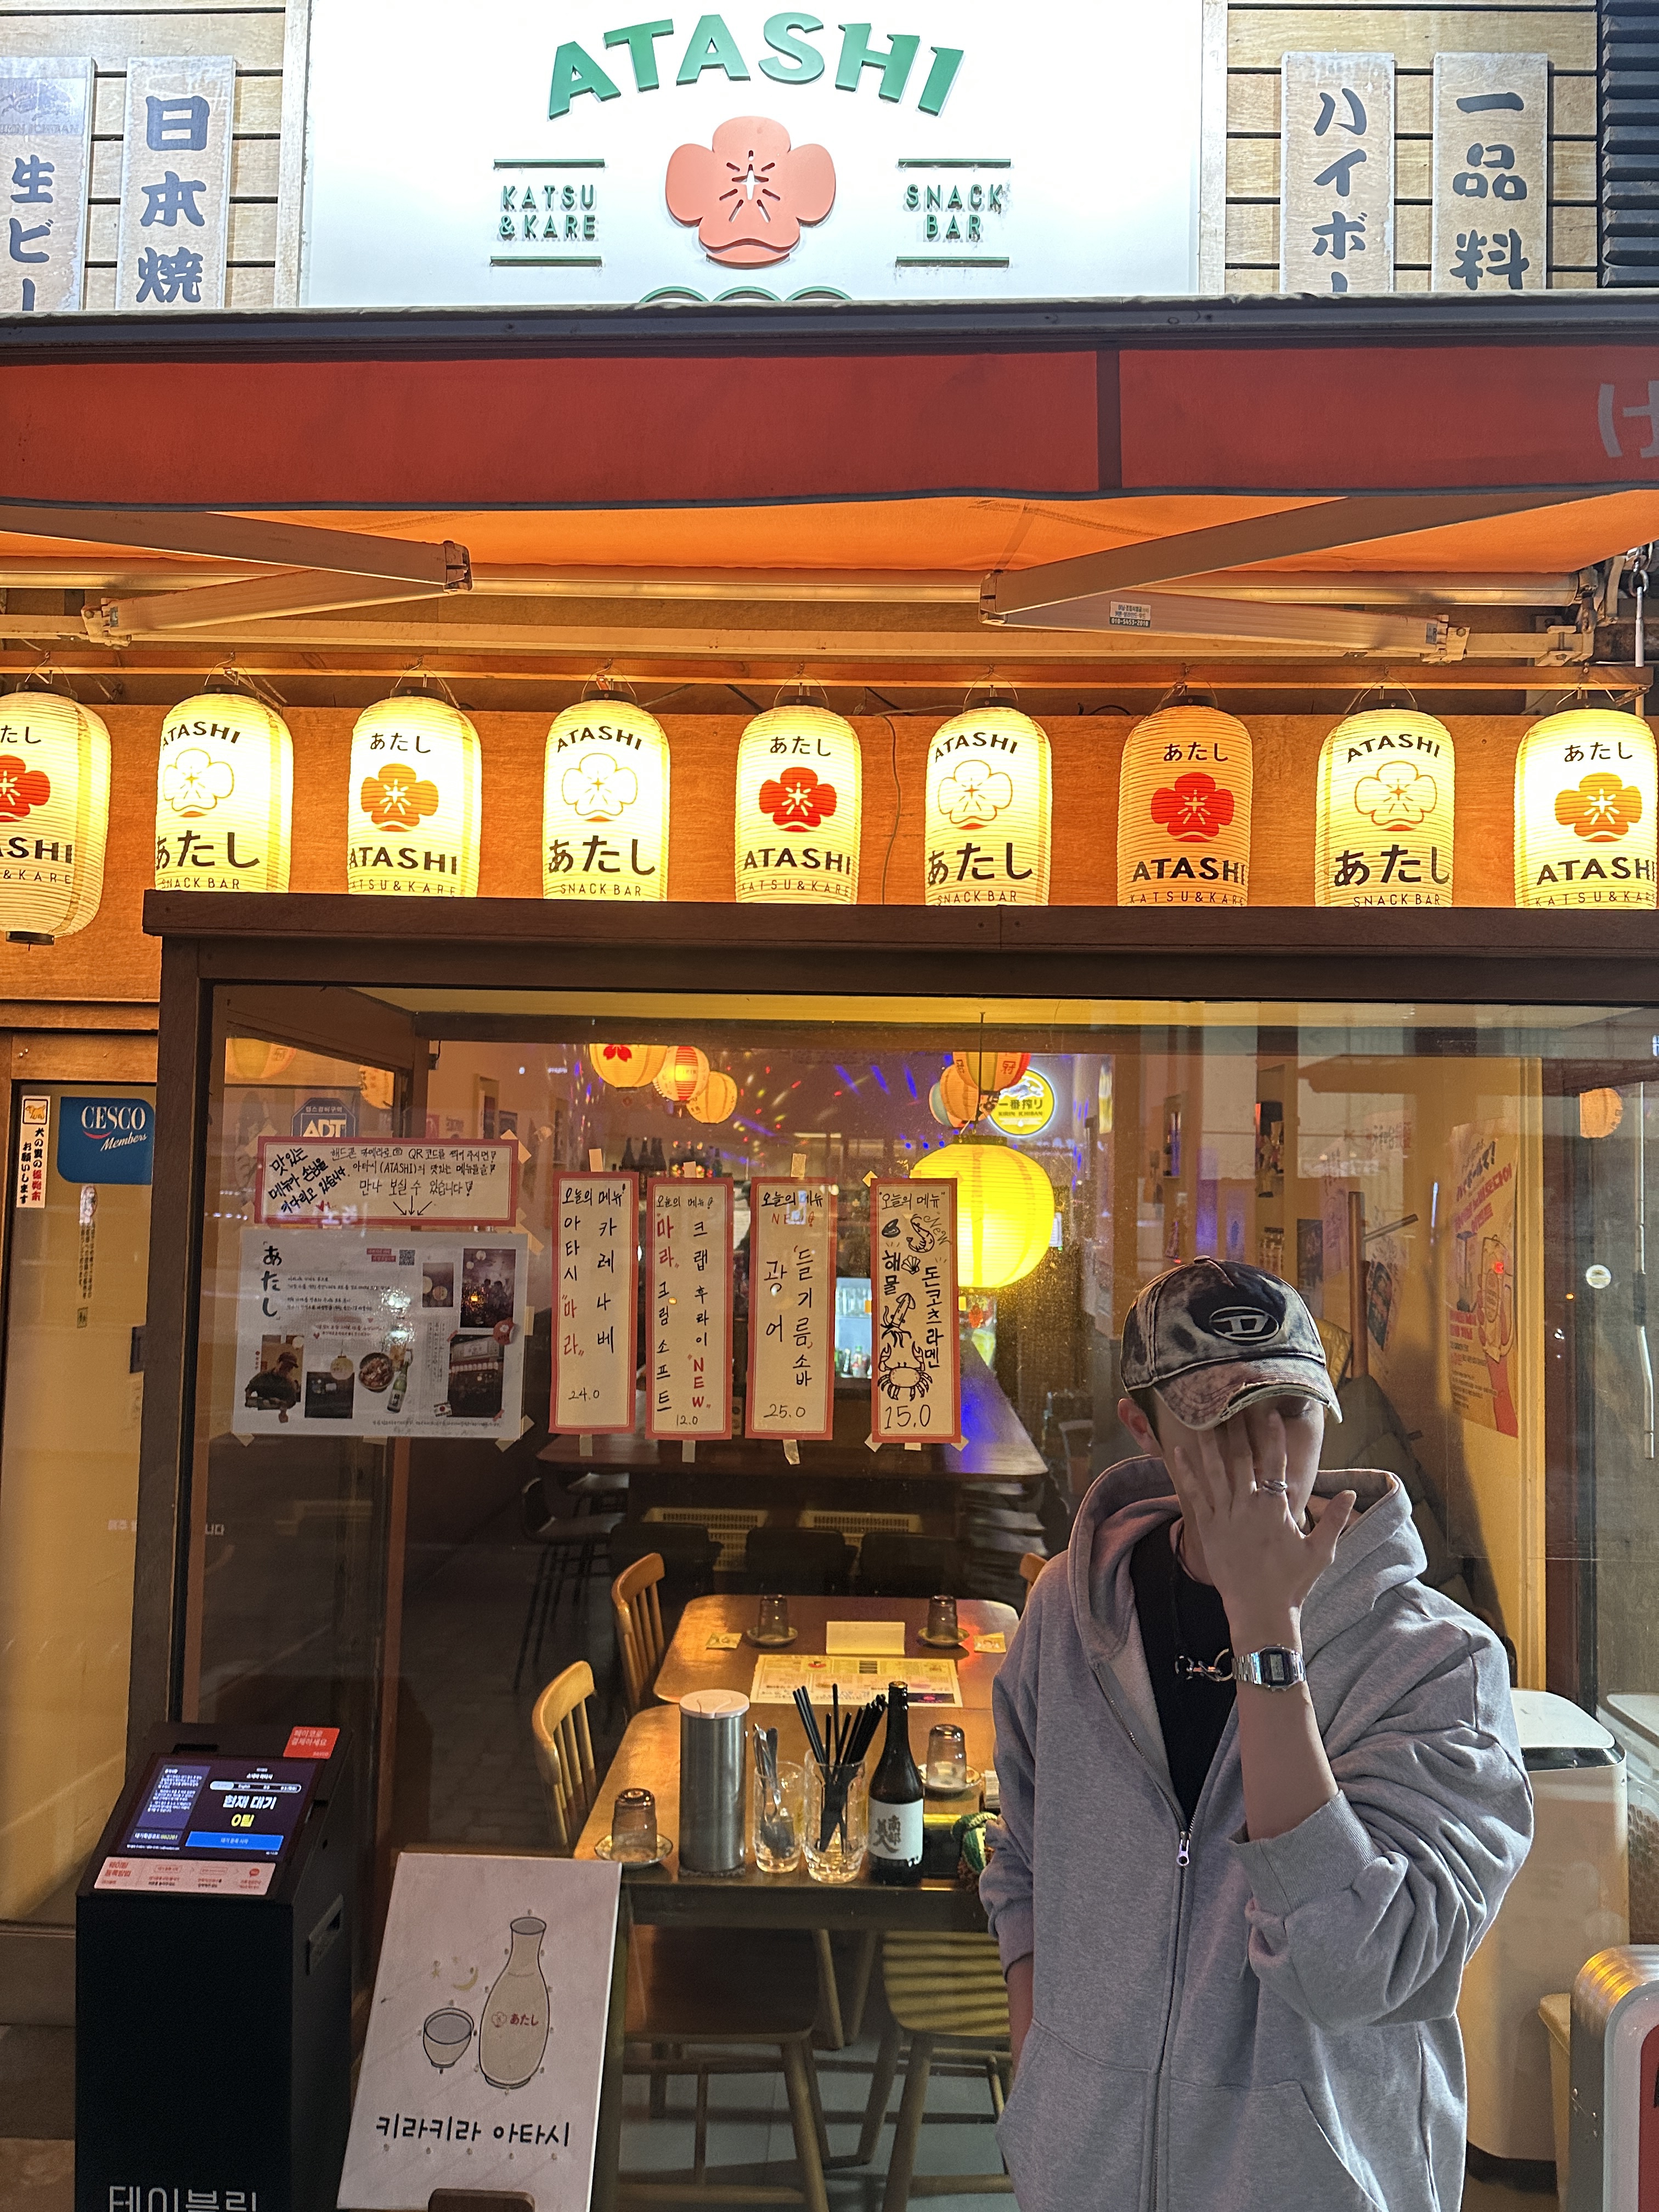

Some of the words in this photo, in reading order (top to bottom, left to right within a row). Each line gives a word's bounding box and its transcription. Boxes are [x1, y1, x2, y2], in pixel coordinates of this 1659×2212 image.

[548, 12, 964, 120] ATASHI
[136, 95, 210, 303] 日本焼
[501, 184, 597, 208] KATSU
[906, 184, 1003, 211] SNACK
[1450, 92, 1530, 290] 一品料
[499, 215, 596, 240] &KARE
[928, 215, 981, 240] BAR
[1, 725, 42, 744] たし
[163, 721, 241, 750] ATASHI
[370, 732, 431, 753] あたし
[557, 726, 642, 753] ATASHI
[770, 736, 831, 757] あたし
[935, 732, 1018, 763] ATASHI
[1163, 741, 1229, 762] あたし
[1347, 733, 1440, 763] ATASHI
[1564, 742, 1633, 762] あたし
[0, 837, 72, 864] SHI
[156, 830, 260, 871] あたし
[349, 847, 457, 876] ATASHI
[549, 835, 656, 876] あたし
[743, 848, 850, 876] ATASHI
[927, 843, 1033, 887] あたし
[1131, 857, 1246, 885] ATASHI
[1334, 844, 1450, 887] あたし
[1536, 856, 1656, 886] ATASHI
[208, 878, 240, 890] BAR
[560, 883, 607, 895] SNACK
[613, 884, 641, 896] BAR
[936, 890, 981, 906] SNACK
[987, 890, 1017, 902] BAR
[1353, 894, 1408, 907] SNACK
[1415, 894, 1441, 906] BAR
[998, 1099, 1043, 1110] 一番搾り
[81, 1105, 146, 1130] CESCO
[303, 1119, 347, 1137] ADT
[100, 1132, 148, 1152] Members
[269, 1147, 308, 1176] 맛있는
[268, 1173, 300, 1199] 메뉴가
[359, 1178, 382, 1196] 만나
[388, 1178, 407, 1196] 보실
[410, 1180, 421, 1195] 수
[562, 1188, 593, 1206] 오늘의
[761, 1190, 796, 1207] 오늘의
[656, 1195, 681, 1208] 오늘의
[882, 1249, 900, 1295] 해물
[568, 1387, 600, 1402] 24.0
[675, 1414, 698, 1426] 12.0
[763, 1403, 806, 1419] 25.0
[884, 1403, 931, 1430] 15.0
[223, 1795, 250, 1809] 현재
[250, 1796, 277, 1810] 대기
[510, 2013, 539, 2026] あたし
[376, 2113, 481, 2141] 키라키라
[493, 2122, 569, 2147] 아타시
